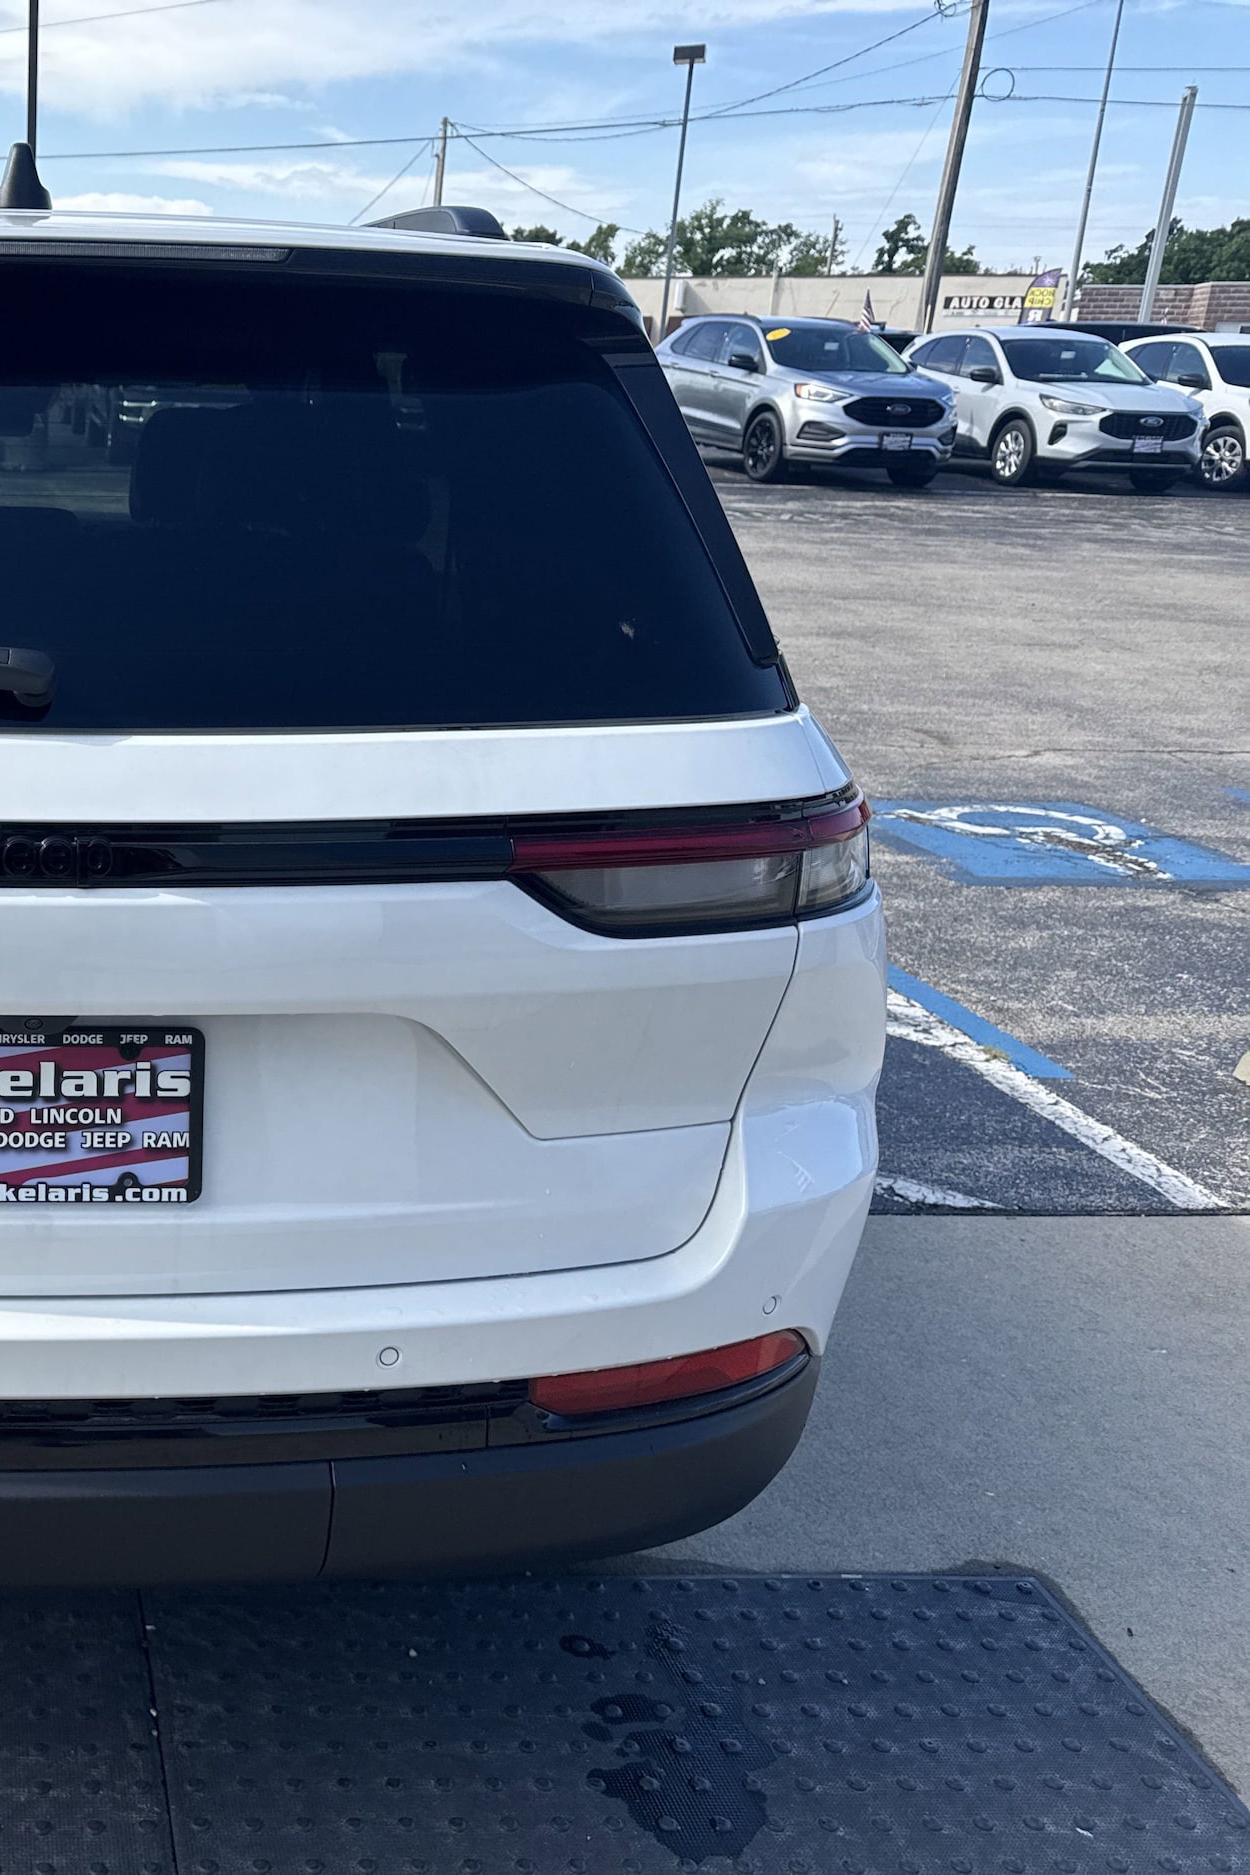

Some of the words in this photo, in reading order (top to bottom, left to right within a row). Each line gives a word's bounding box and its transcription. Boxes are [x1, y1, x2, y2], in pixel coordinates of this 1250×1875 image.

[950, 296, 990, 309] AUTO
[993, 296, 1023, 309] GLA
[62, 1034, 103, 1045] DODGE
[119, 1034, 148, 1045] JEEP
[164, 1034, 193, 1045] RAM
[30, 1108, 122, 1125] LINCOLN
[81, 1131, 132, 1149] JEEP
[142, 1131, 190, 1149] RAM
